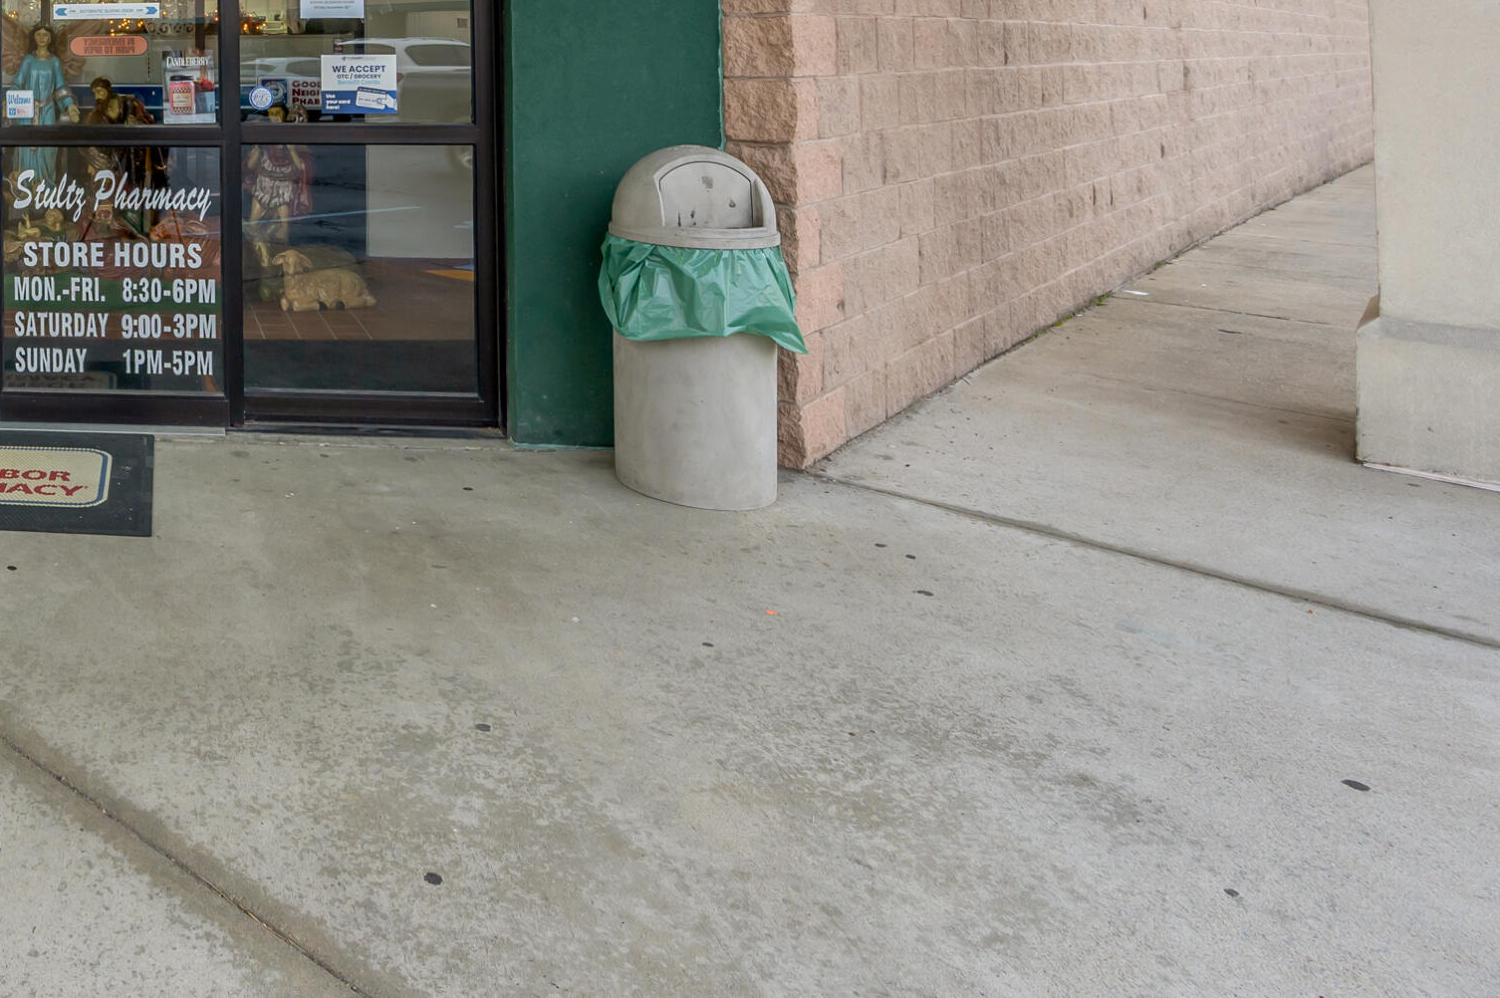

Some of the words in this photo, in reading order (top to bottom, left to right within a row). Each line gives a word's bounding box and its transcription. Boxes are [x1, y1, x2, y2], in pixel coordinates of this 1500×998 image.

[166, 57, 210, 67] CANDLEBERRY
[332, 65, 346, 73] WE
[349, 65, 386, 73] ACCEPT
[8, 94, 31, 105] Welcome
[14, 169, 86, 222] Stultz
[94, 170, 212, 222] Pharmacy
[24, 242, 104, 267] STORE
[114, 242, 202, 268] HOURS
[14, 276, 105, 302] MON.-FRI.
[122, 278, 216, 304] 8:30-6PM
[14, 311, 109, 337] SATURDAY
[121, 314, 216, 339] 9:00-3PM
[15, 347, 87, 373] SUNDAY
[122, 349, 213, 376] 1PM-5PM
